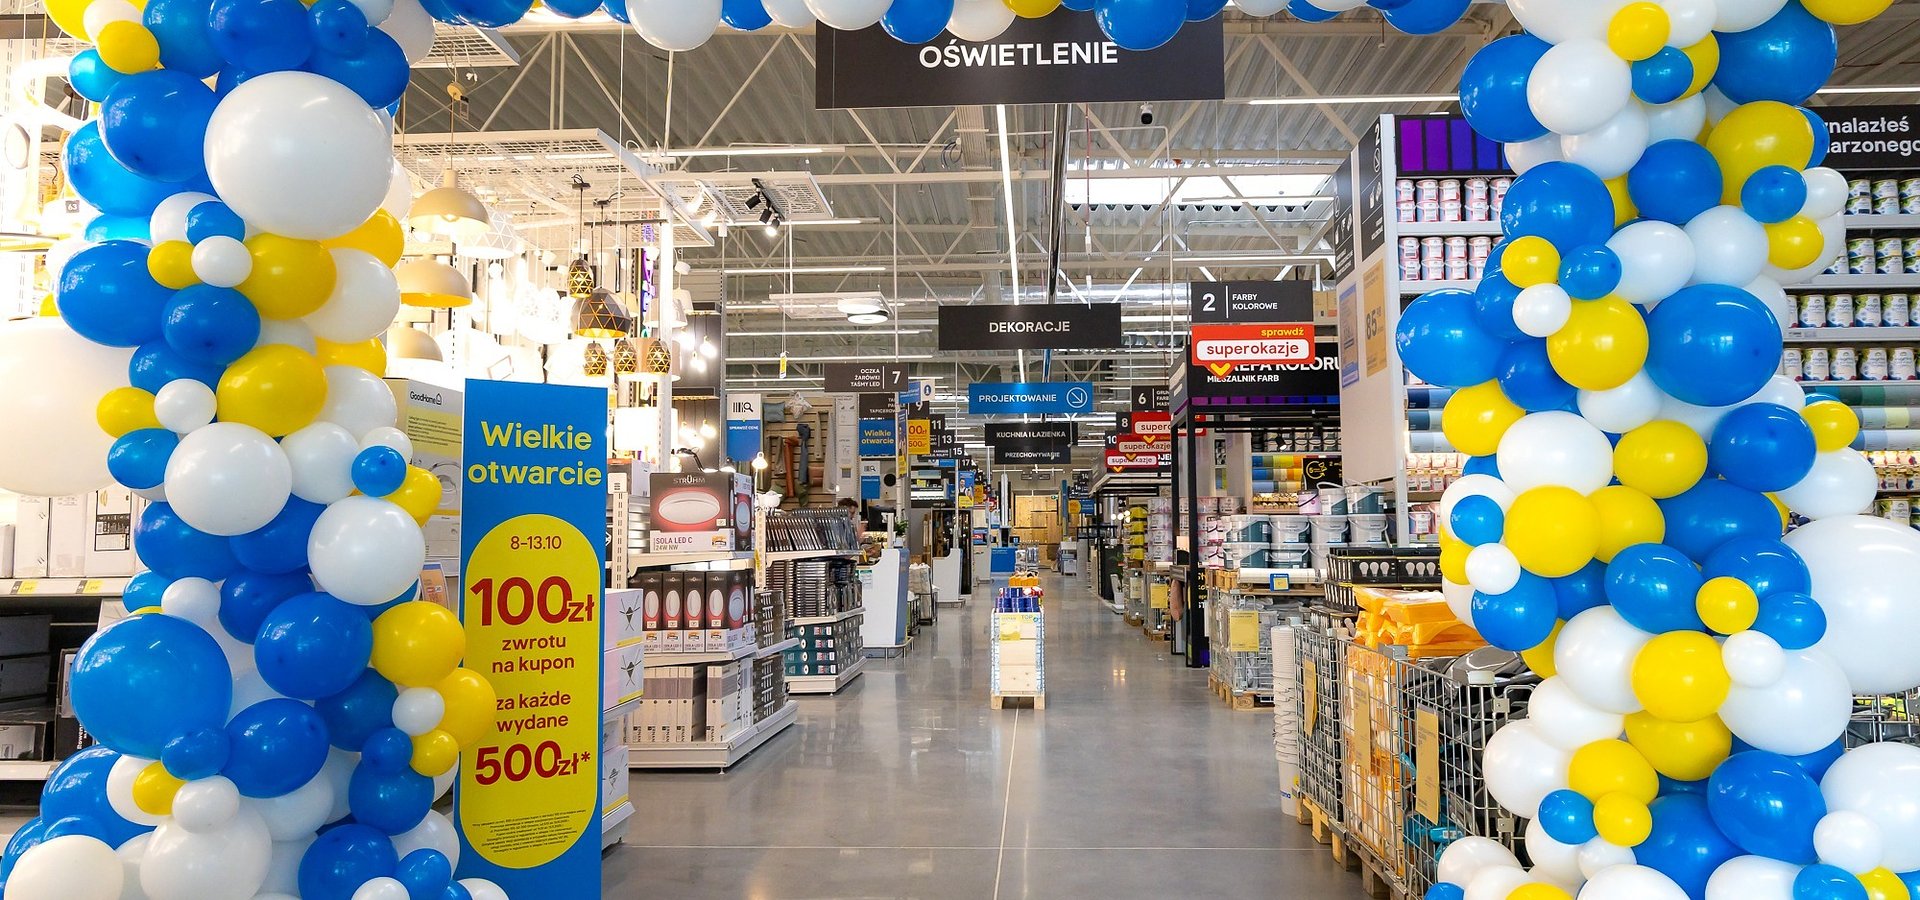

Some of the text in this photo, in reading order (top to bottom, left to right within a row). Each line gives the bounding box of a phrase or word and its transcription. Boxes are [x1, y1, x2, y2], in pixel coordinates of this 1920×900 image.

[919, 39, 1118, 68] OŚWIETLENIE
[1825, 115, 1910, 134] nalazłeś
[1374, 123, 1381, 146] 2
[1826, 140, 1920, 157] arzonego
[1202, 293, 1216, 312] 2
[1232, 293, 1258, 301] FARBY
[1232, 302, 1278, 310] KOLOROWE
[989, 321, 1070, 333] DEKORACJE
[1261, 327, 1305, 338] sprawdź
[1206, 341, 1299, 358] superokazje
[892, 371, 901, 384] 7
[1257, 374, 1280, 382] FARB
[978, 394, 1057, 403] PROJEKTOWANIE
[1138, 393, 1147, 405] 6
[915, 401, 924, 412] 9
[931, 420, 942, 430] 11
[1121, 417, 1129, 428] 8
[481, 420, 592, 451] Wielkie
[864, 429, 892, 437] Wielkie
[942, 434, 952, 444] 13
[1106, 435, 1117, 445] 10
[953, 447, 963, 456] 15
[1111, 457, 1153, 465] supekazje
[467, 460, 602, 486] otwarcie
[470, 575, 595, 627] 100zł
[502, 635, 567, 651] zwrotu
[492, 656, 575, 675] na kupon
[496, 690, 572, 711] za każde
[496, 713, 569, 736] wydane
